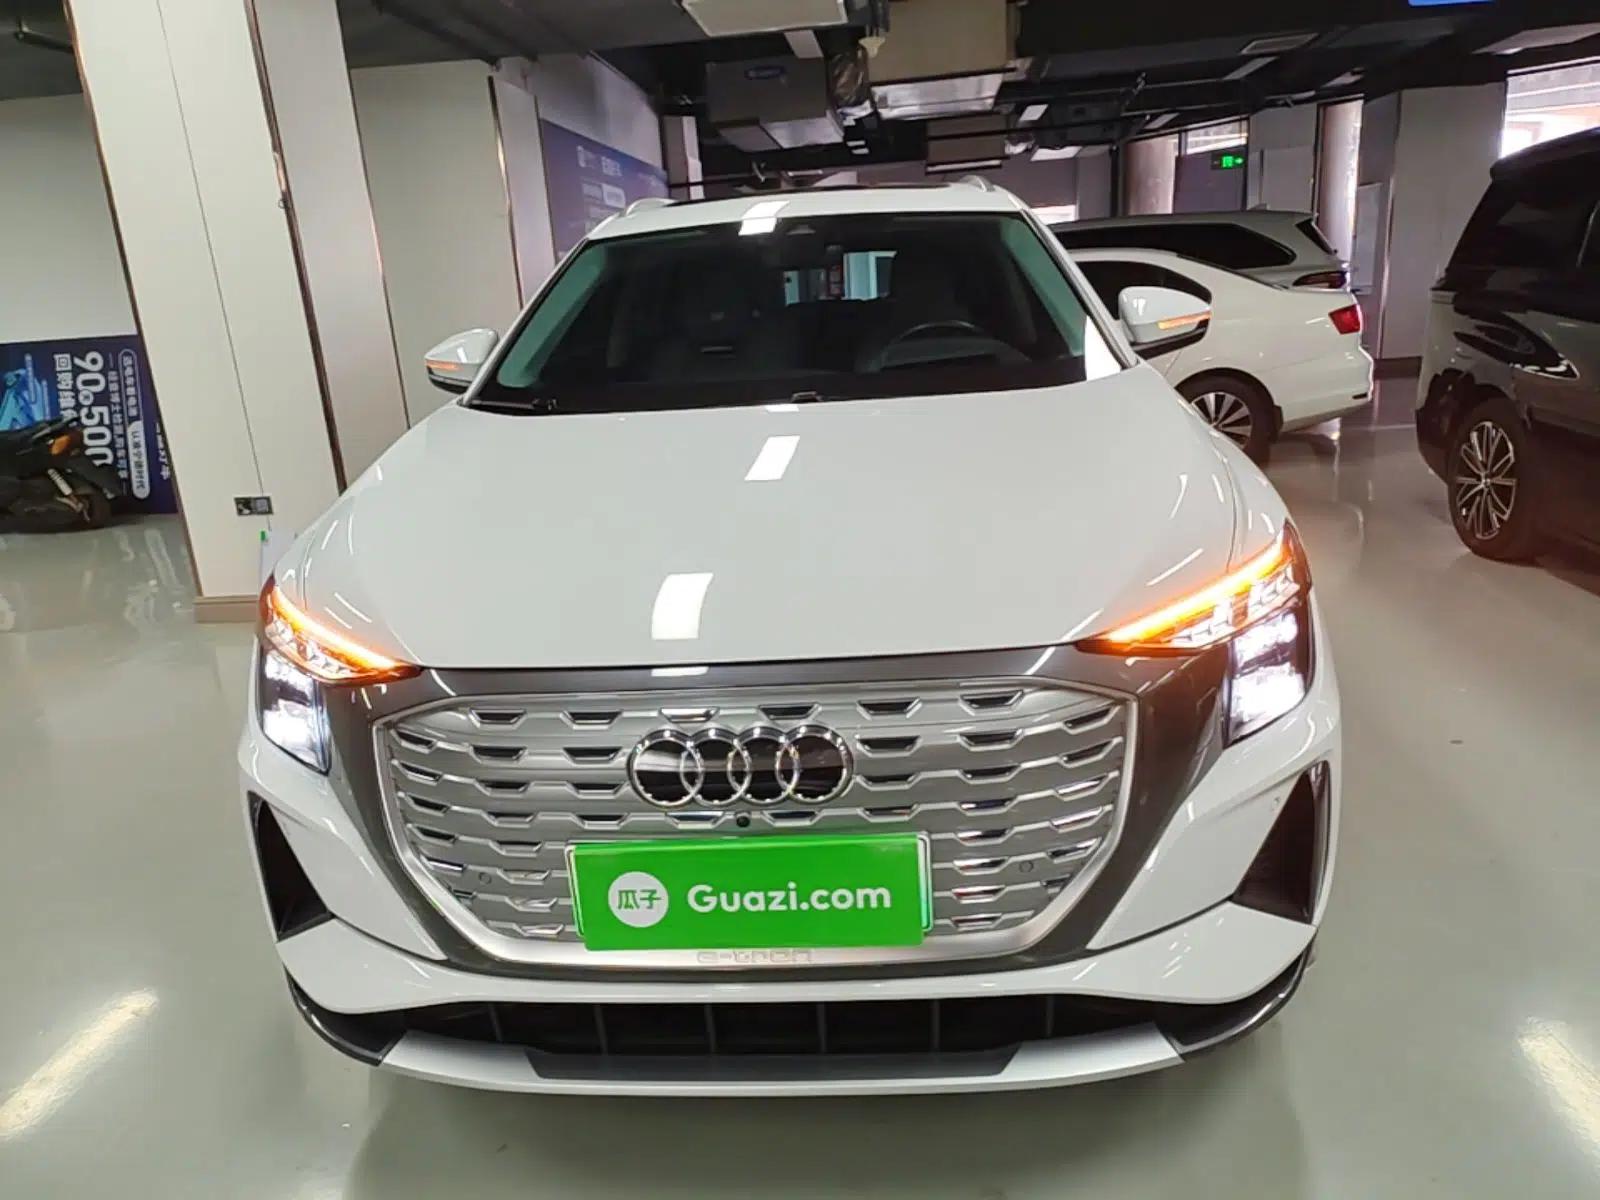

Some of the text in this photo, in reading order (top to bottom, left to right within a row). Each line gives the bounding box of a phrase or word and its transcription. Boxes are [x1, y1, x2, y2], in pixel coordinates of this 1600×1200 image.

[617, 881, 892, 913] 瓜子 Guazi.com
[697, 950, 812, 964] e-tron
